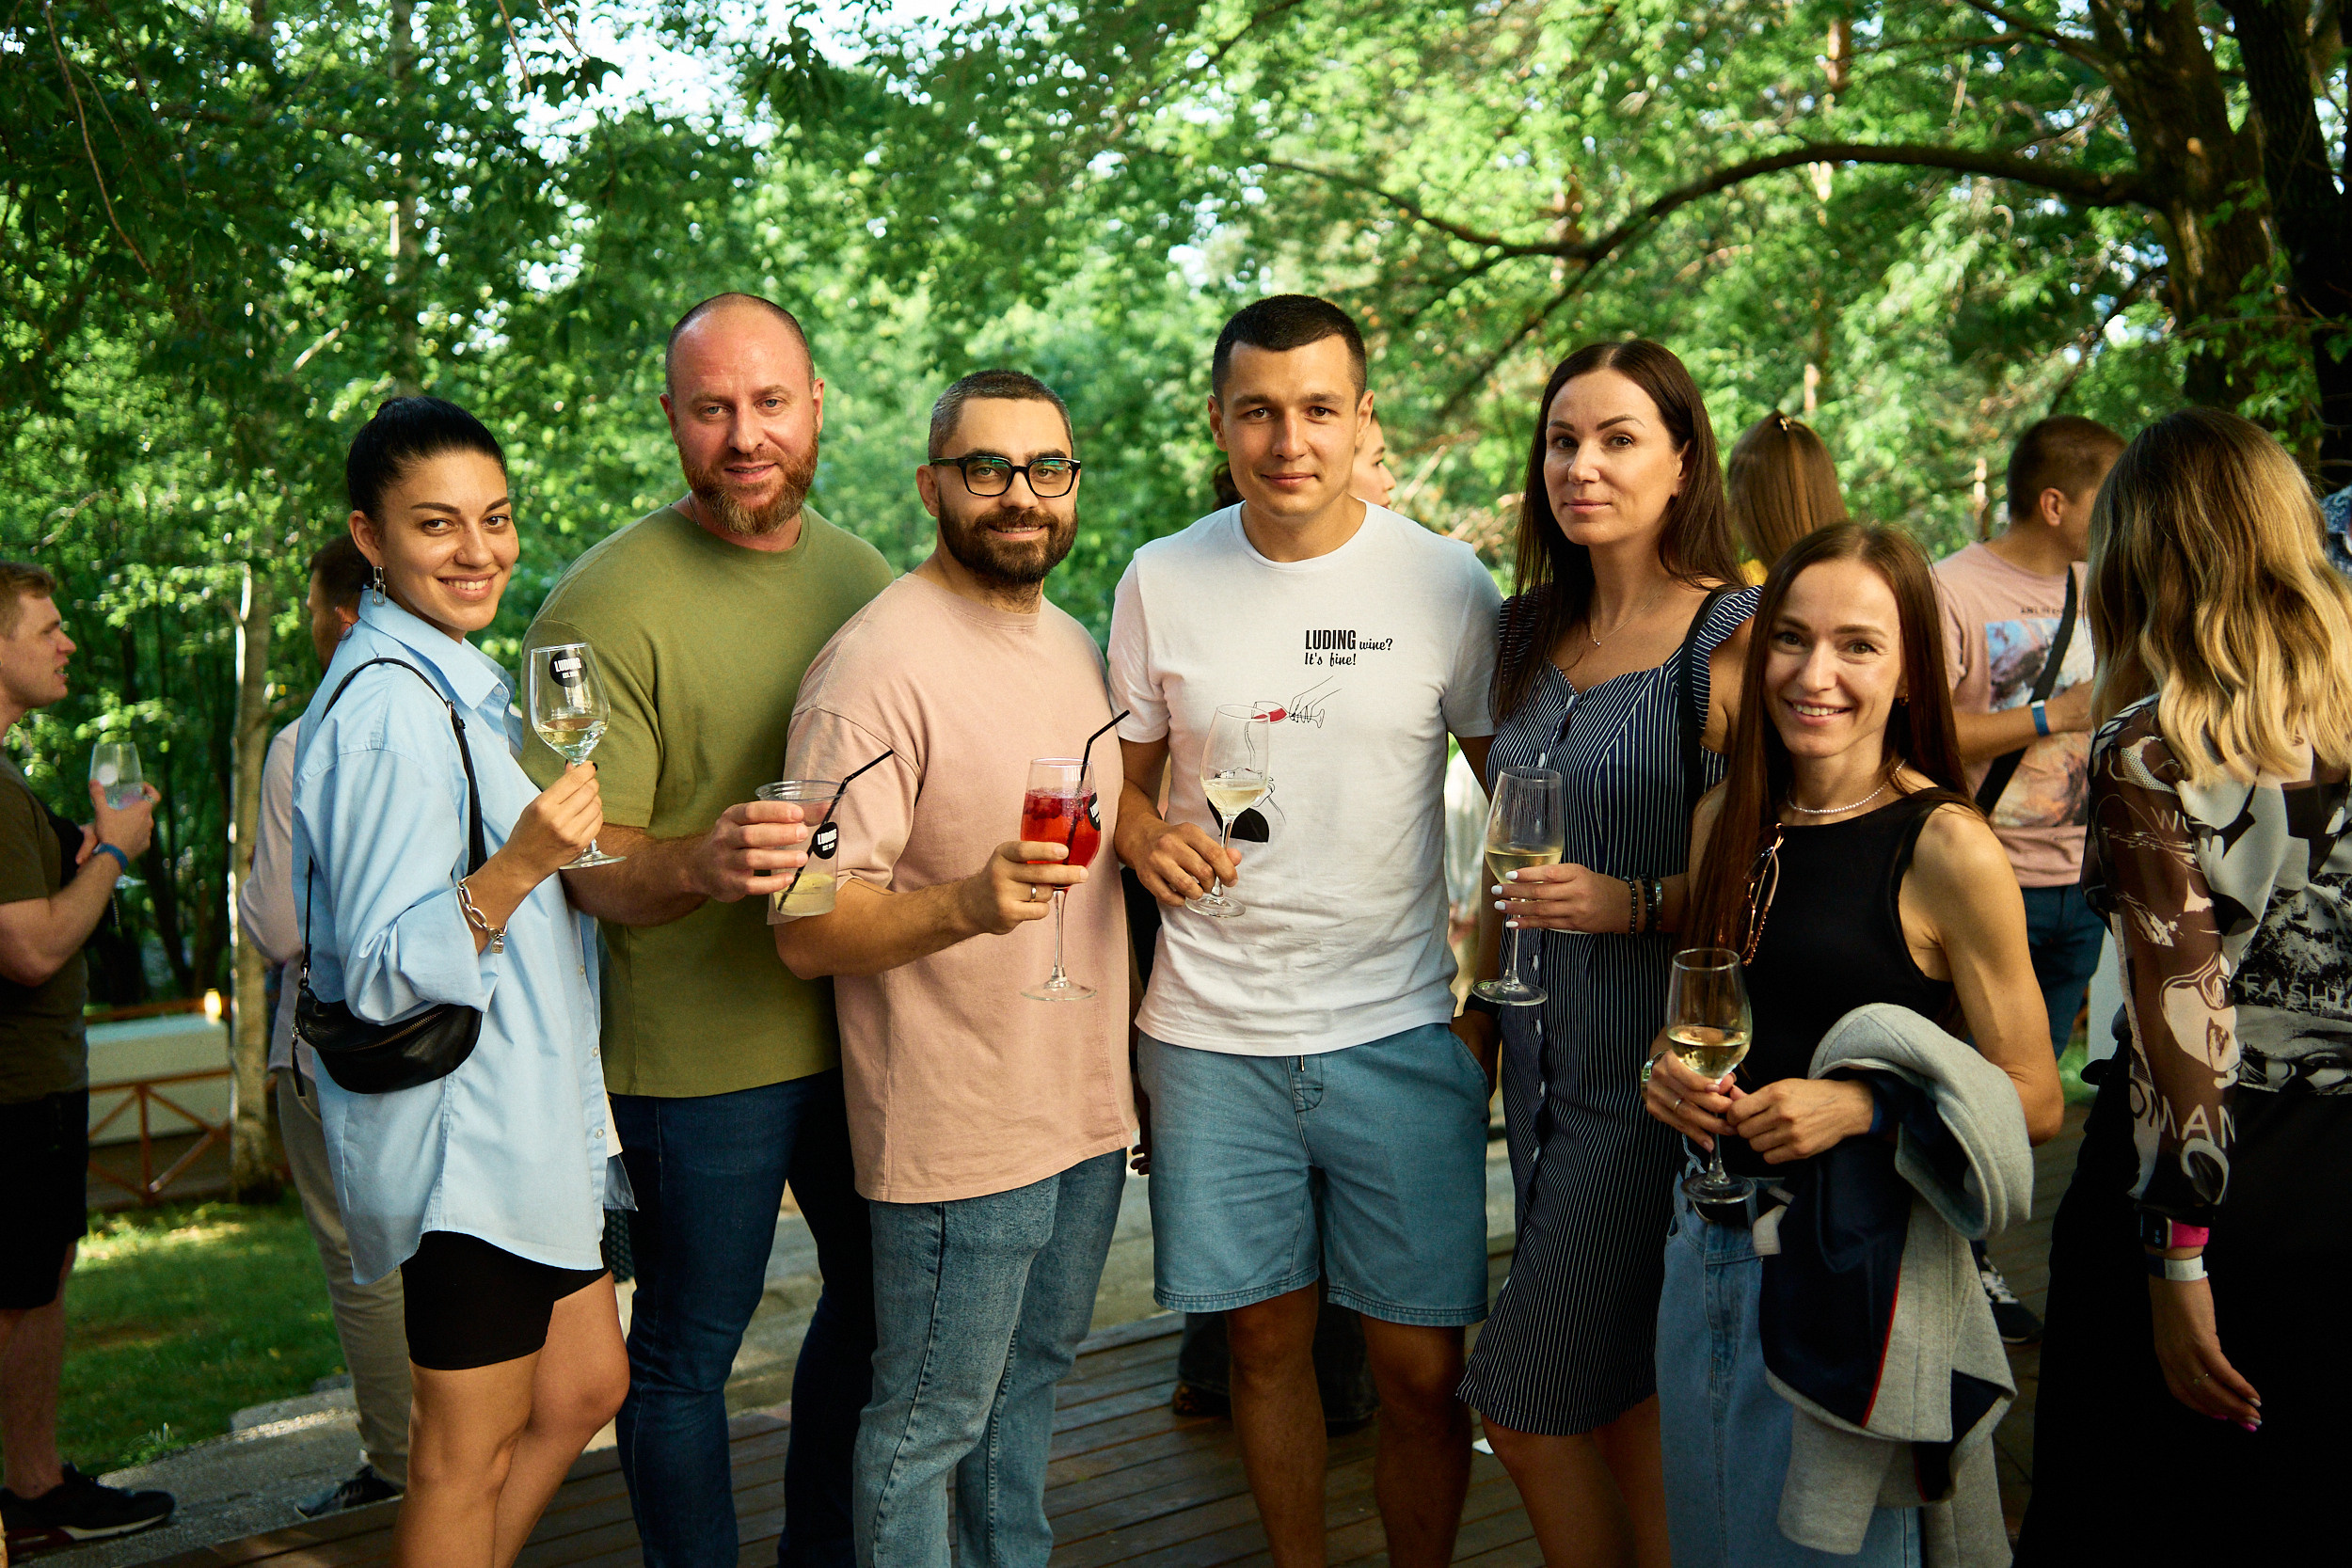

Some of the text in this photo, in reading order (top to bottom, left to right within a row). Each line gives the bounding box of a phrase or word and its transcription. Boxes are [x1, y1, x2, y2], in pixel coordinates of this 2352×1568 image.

[1305, 629, 1393, 651] LUDING wine?
[1304, 652, 1357, 667] It's fine!
